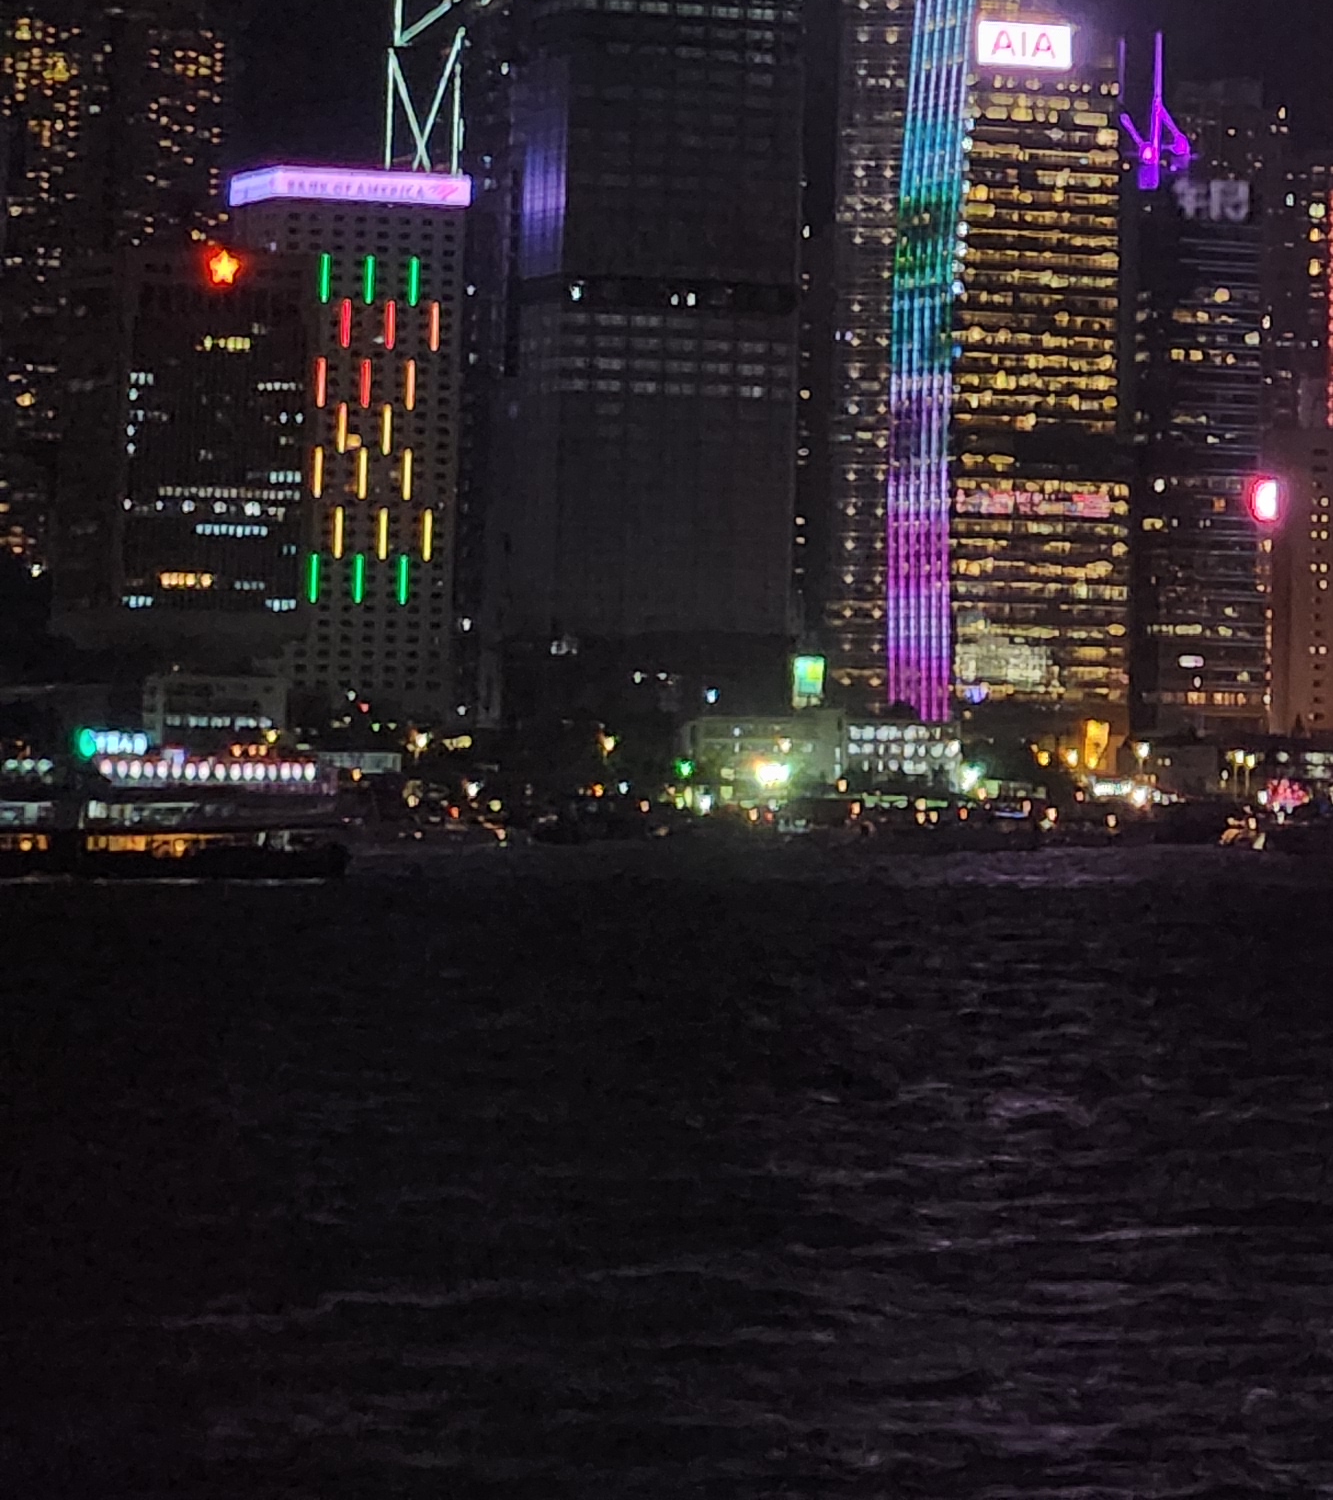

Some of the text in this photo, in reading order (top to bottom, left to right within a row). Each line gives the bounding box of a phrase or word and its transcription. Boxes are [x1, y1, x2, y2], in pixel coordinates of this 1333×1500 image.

[991, 30, 1056, 60] AIA
[286, 179, 426, 200] BANK OF AMERICA
